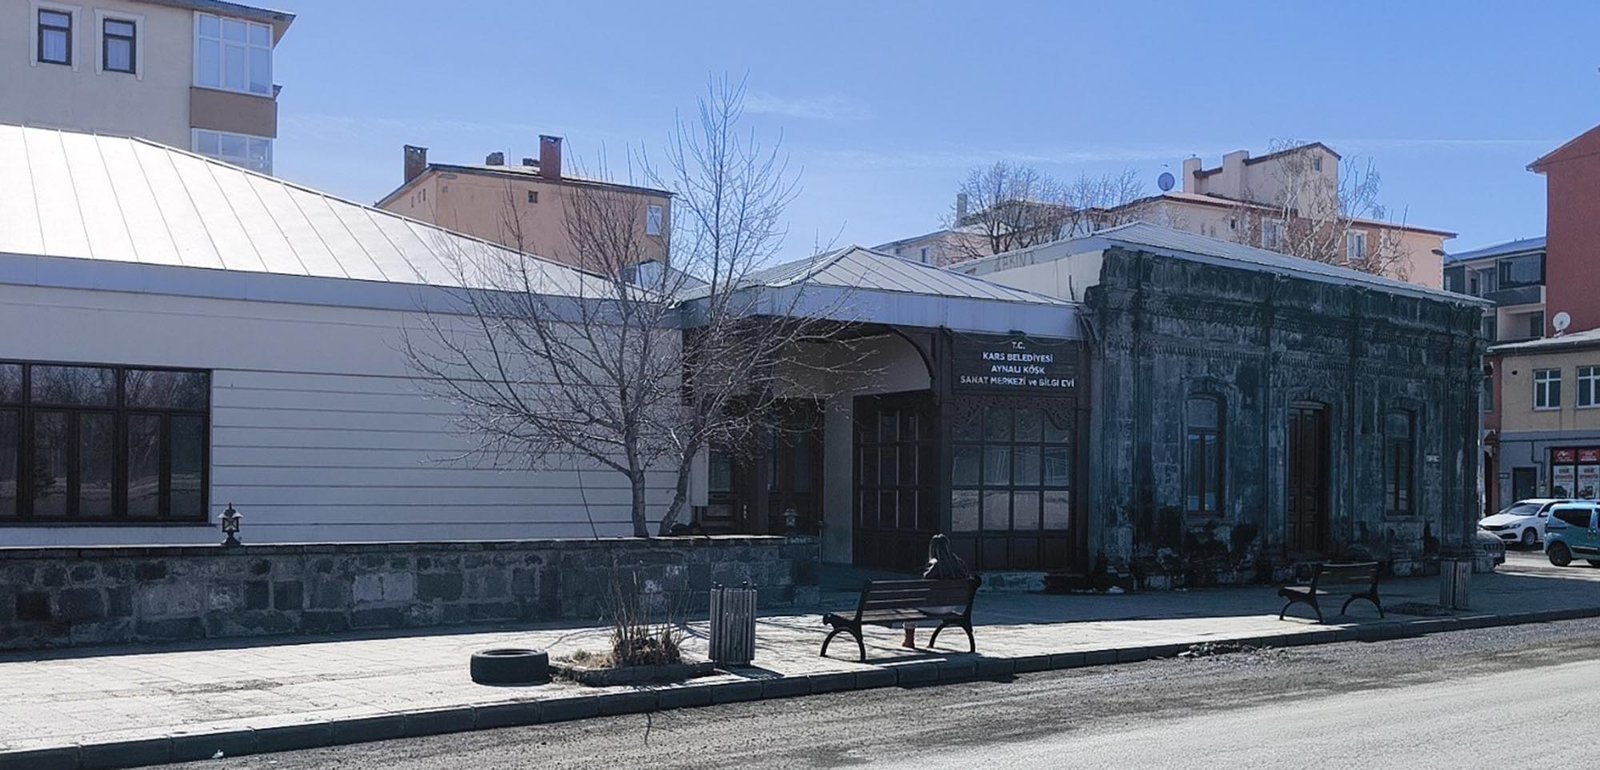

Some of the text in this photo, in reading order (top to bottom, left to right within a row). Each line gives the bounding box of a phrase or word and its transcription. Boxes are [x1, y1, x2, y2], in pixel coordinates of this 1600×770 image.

[1012, 341, 1026, 350] T.C.
[983, 352, 1054, 363] KARS BELEDİYESİ
[991, 364, 1045, 375] AYNALI KÖŞK
[960, 375, 988, 384] SANAT
[990, 375, 1026, 386] MERKEZİ
[1028, 379, 1037, 387] ve
